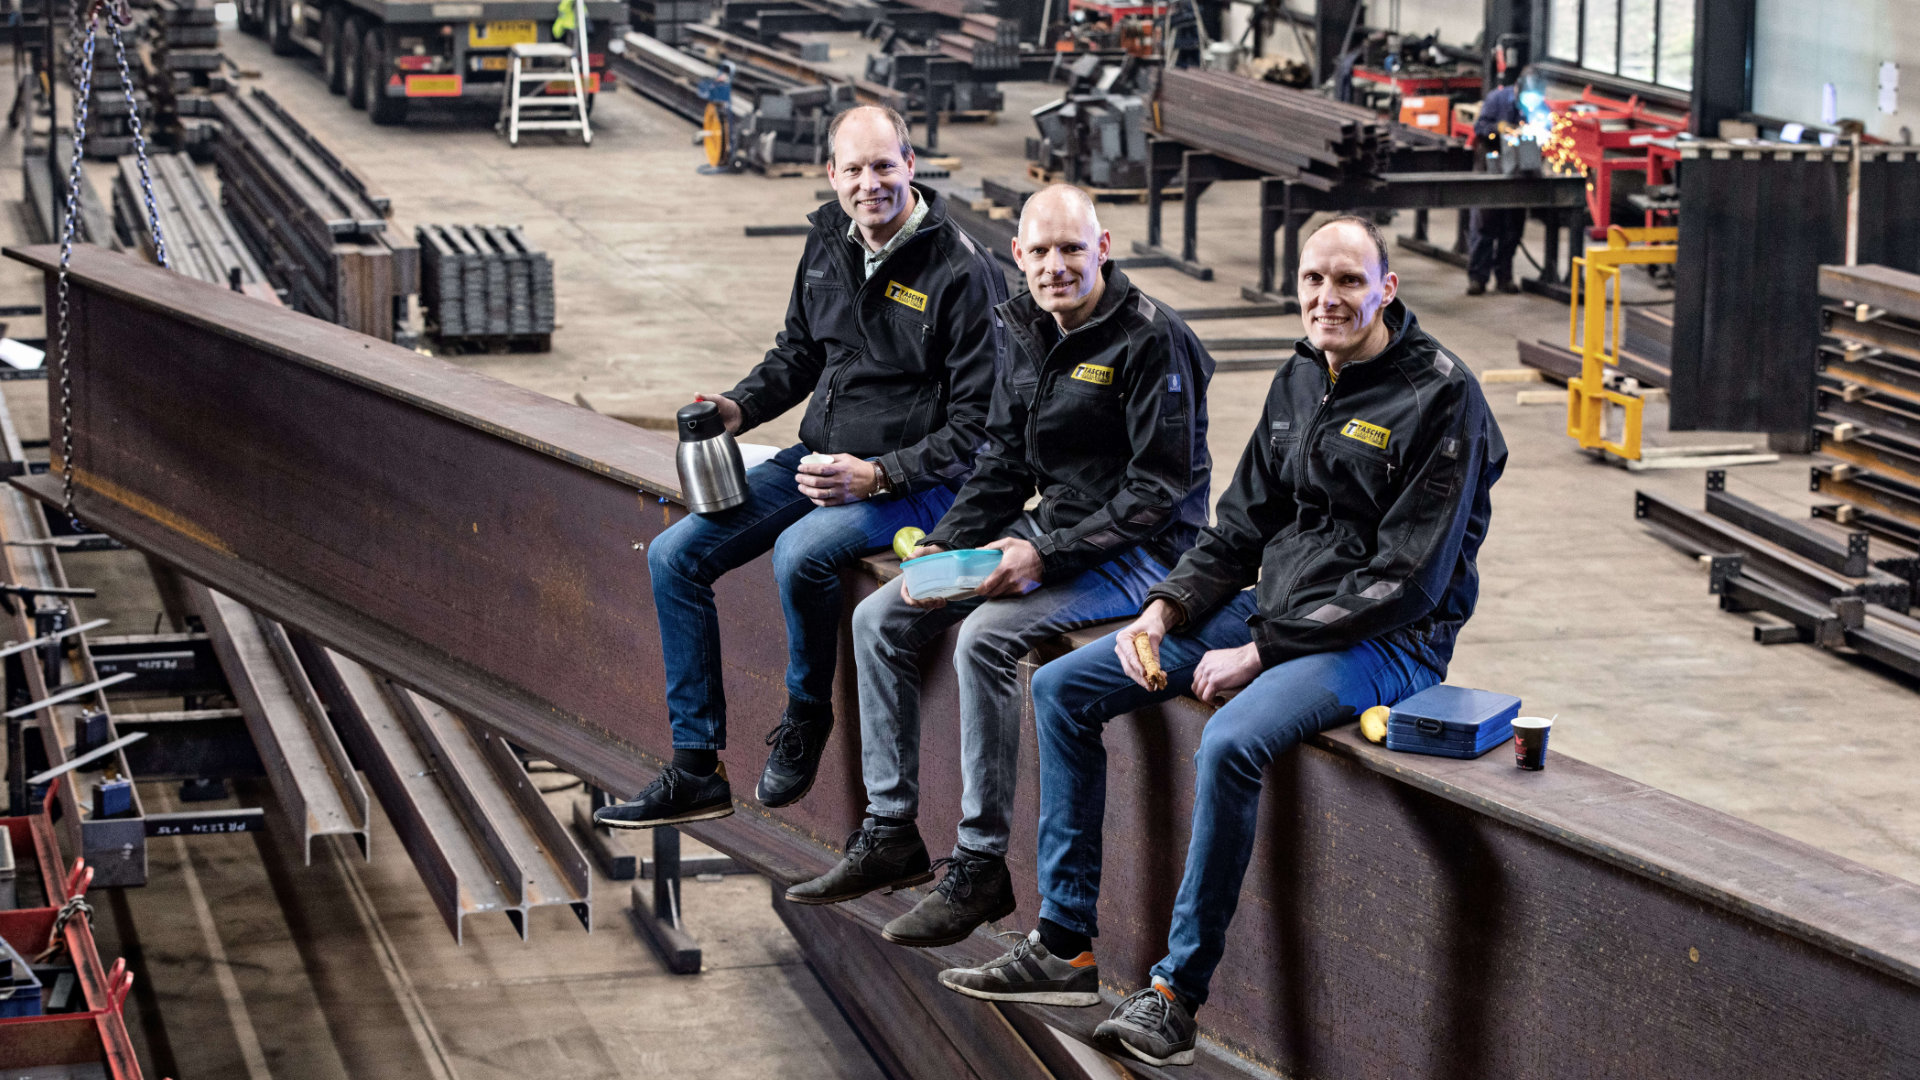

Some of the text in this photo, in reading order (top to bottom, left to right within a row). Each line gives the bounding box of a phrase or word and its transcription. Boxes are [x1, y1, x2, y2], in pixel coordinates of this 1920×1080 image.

[900, 289, 924, 303] TASCHE
[1084, 367, 1111, 379] TASCHE
[1357, 424, 1387, 440] TASCHE
